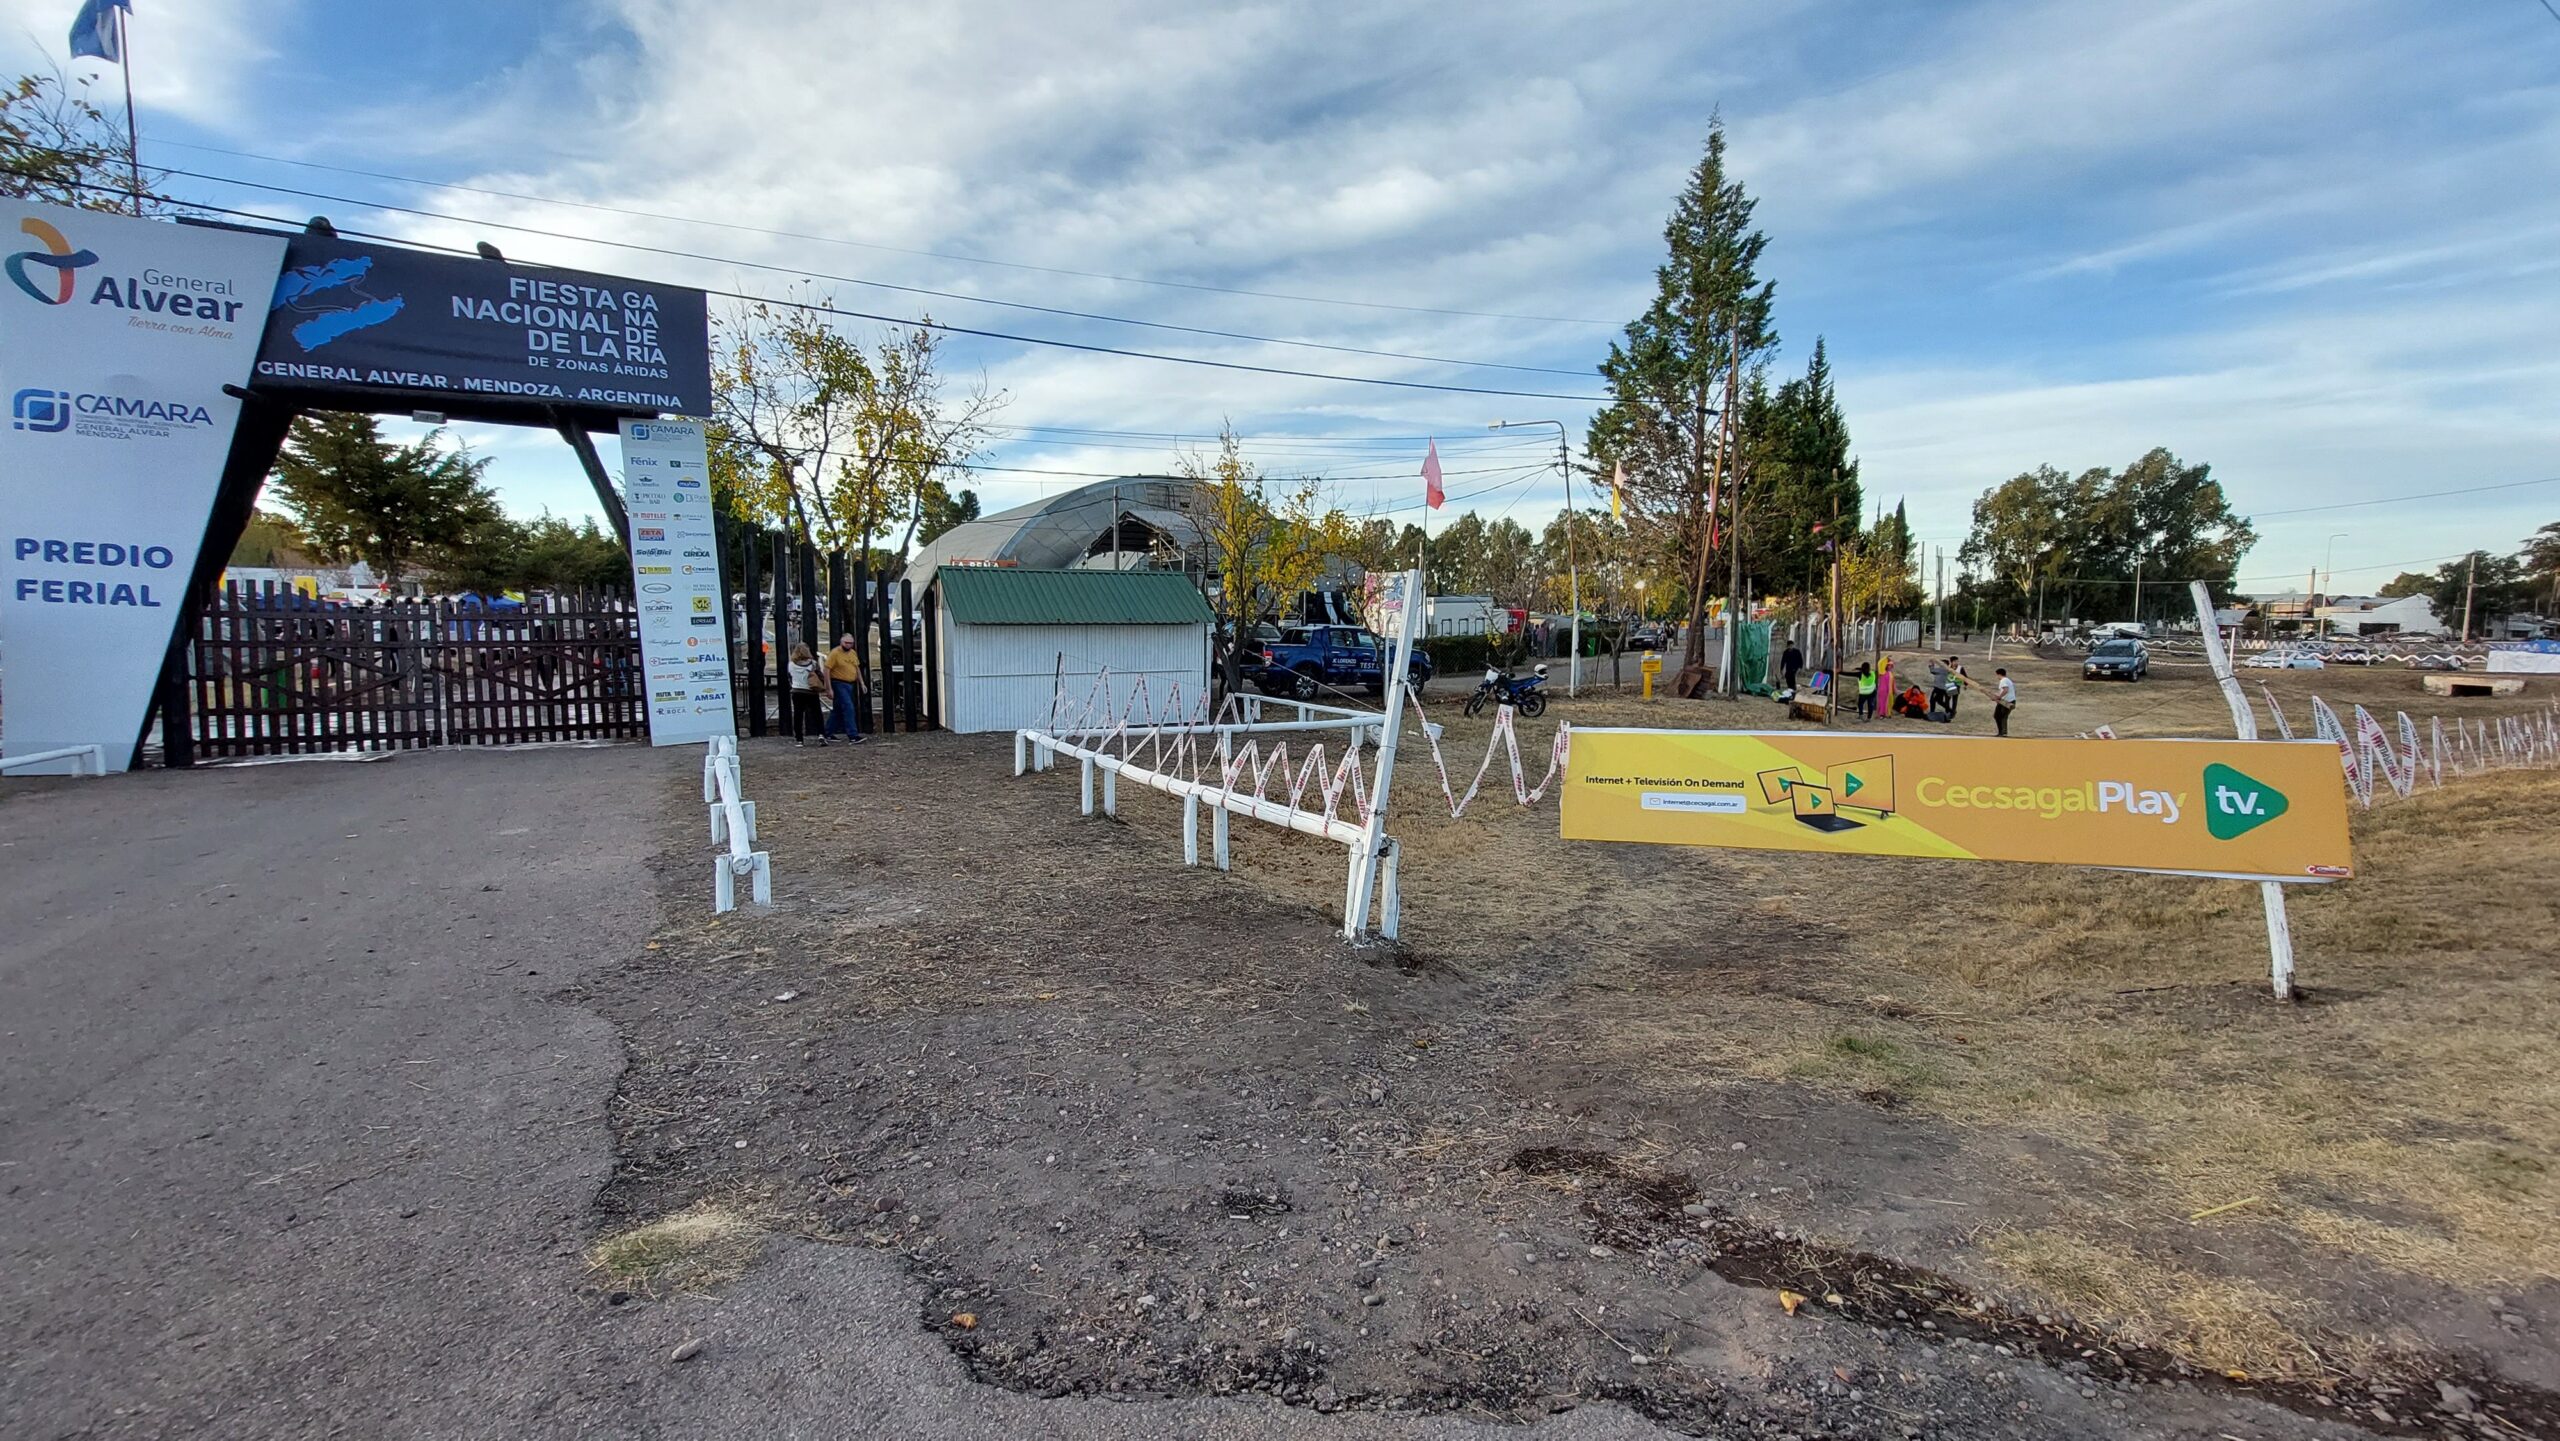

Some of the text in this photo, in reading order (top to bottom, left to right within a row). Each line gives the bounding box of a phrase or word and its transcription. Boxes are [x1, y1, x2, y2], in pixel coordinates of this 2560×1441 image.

[143, 268, 234, 296] General
[509, 276, 617, 311] FIESTA
[90, 276, 244, 323] Alvear
[622, 291, 659, 312] GA
[128, 315, 234, 340] Tierra con Alma
[451, 295, 619, 336] NACIONAL
[624, 309, 658, 329] NA
[528, 328, 620, 360] DE LA
[625, 326, 658, 347] DE
[528, 355, 669, 380] DE ZONAS ÁRIDAS
[626, 344, 668, 366] RIA
[257, 360, 362, 382] GENERAL
[367, 369, 448, 389] ALVEAR
[464, 377, 564, 399] MENDOZA
[578, 387, 683, 409] ARGENTINA
[75, 423, 126, 434] GENERAL
[129, 428, 170, 439] ALVEAR
[75, 430, 132, 440] MENDOZA
[15, 538, 174, 569] PREDIO
[16, 579, 161, 608] FERIAL
[699, 654, 716, 663] FAI
[694, 693, 726, 702] AMSAT
[1585, 775, 1624, 785] Internet
[1633, 775, 1682, 787] Televisión
[1684, 778, 1699, 787] On
[1701, 778, 1745, 789] Demand
[1915, 776, 2187, 825] CecsagalPlay
[2214, 784, 2265, 816] tv.
